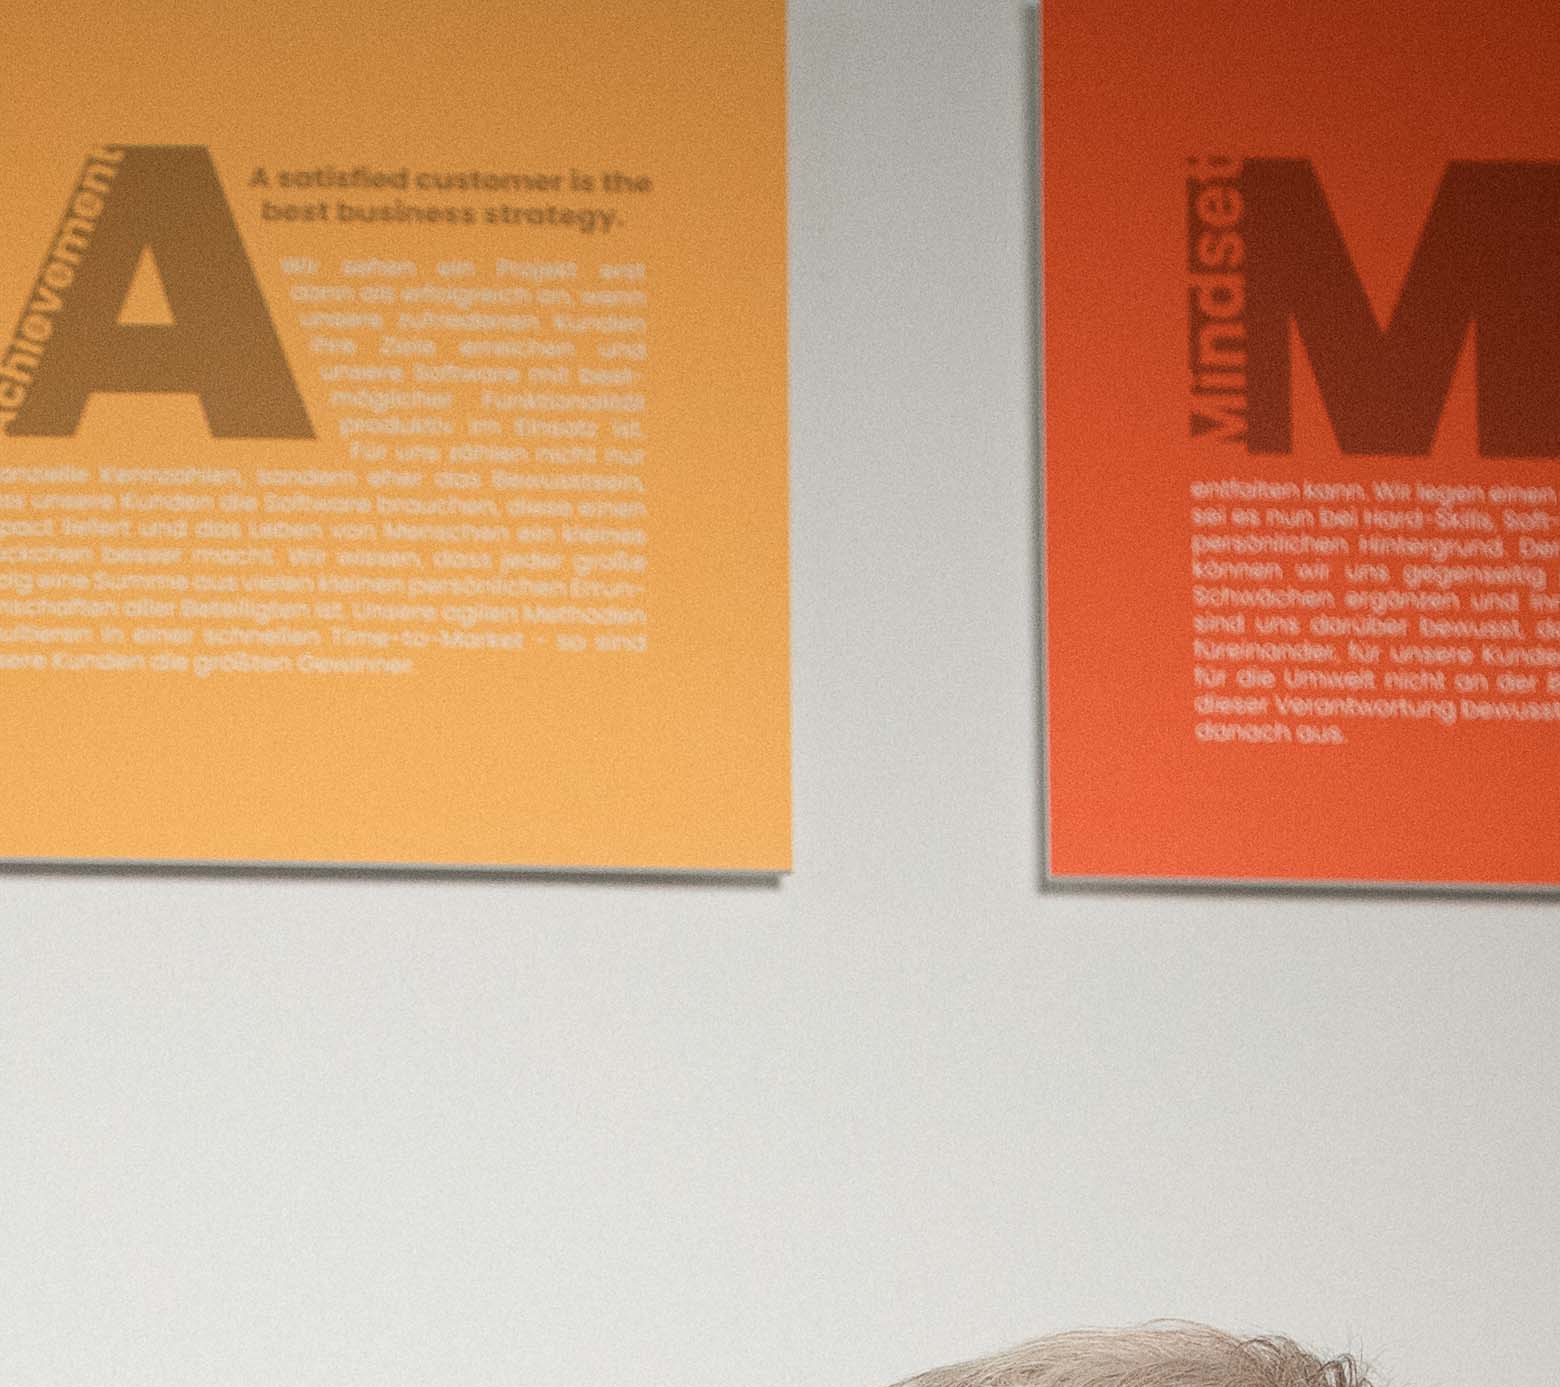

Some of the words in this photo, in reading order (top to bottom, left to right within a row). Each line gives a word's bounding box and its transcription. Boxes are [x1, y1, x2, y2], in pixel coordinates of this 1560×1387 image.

[247, 165, 271, 190] A
[275, 164, 410, 191] satisfied
[415, 167, 564, 193] customer
[568, 165, 597, 193] is
[601, 167, 655, 195] the
[261, 200, 330, 224] best
[337, 198, 478, 226] business
[484, 203, 634, 237] strategy.
[1186, 153, 1249, 453] Mindset
